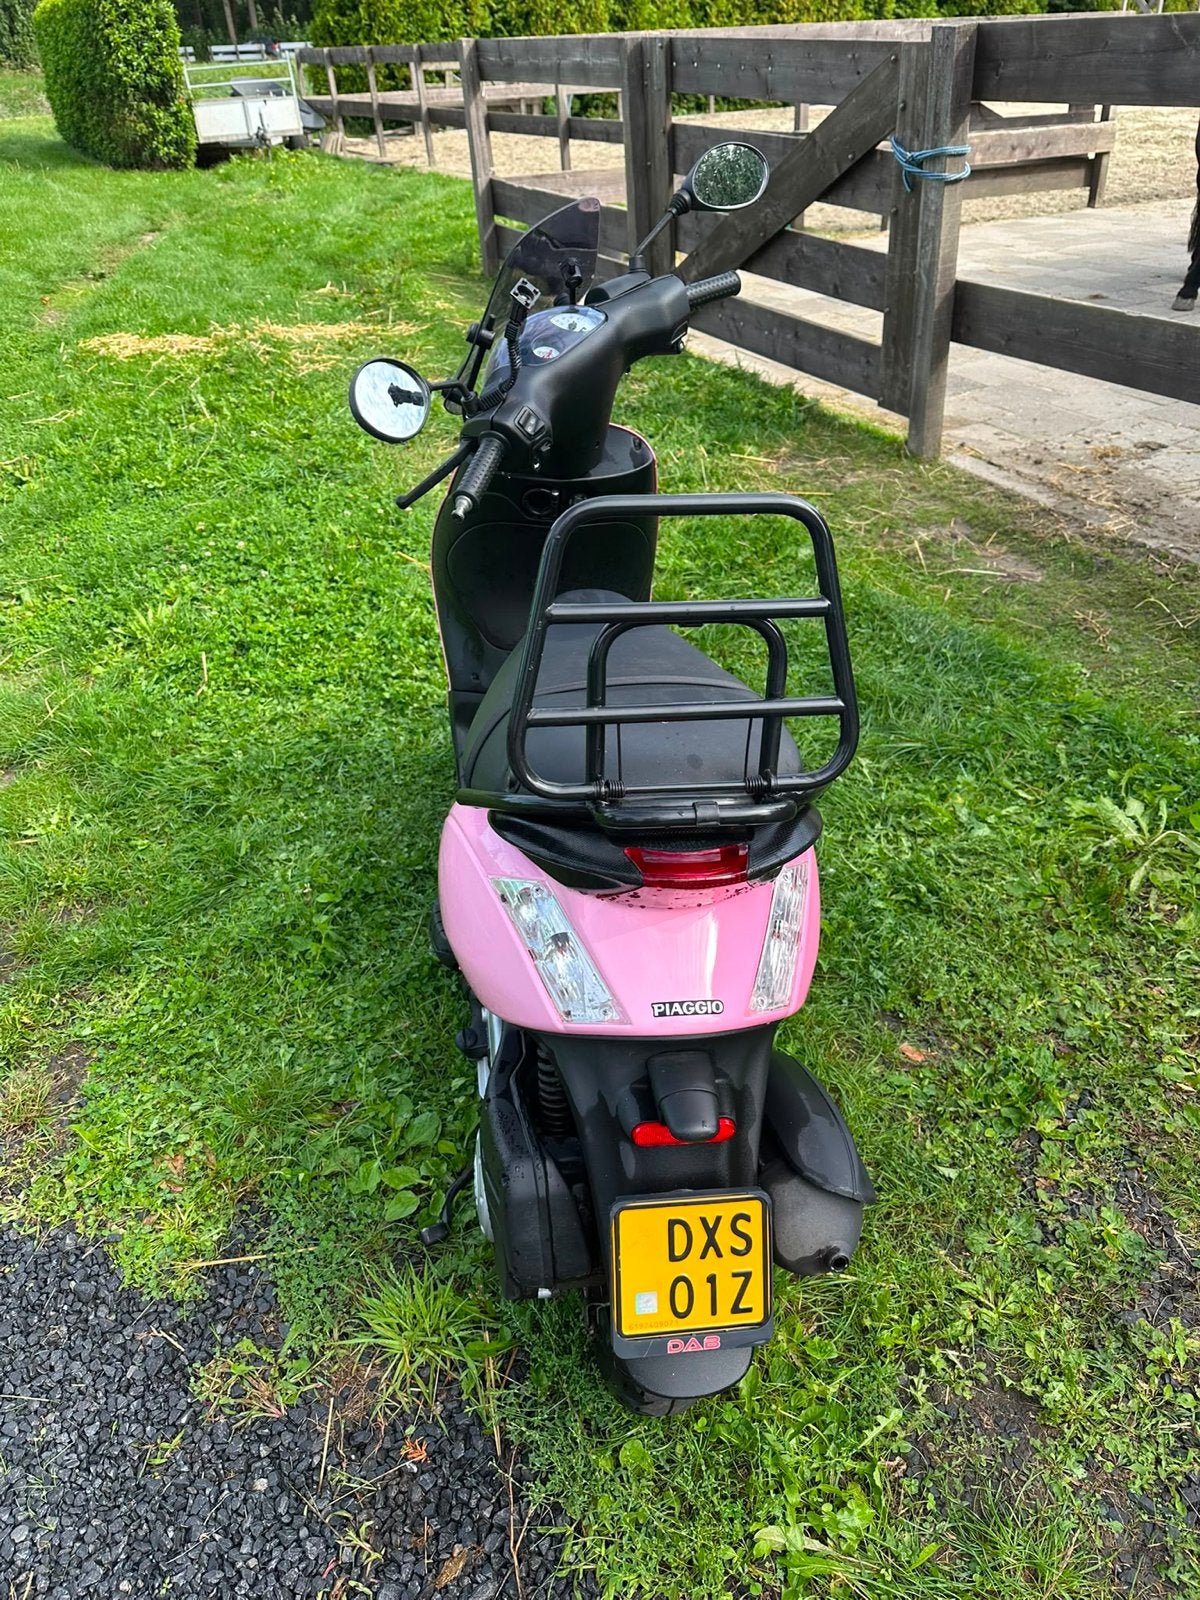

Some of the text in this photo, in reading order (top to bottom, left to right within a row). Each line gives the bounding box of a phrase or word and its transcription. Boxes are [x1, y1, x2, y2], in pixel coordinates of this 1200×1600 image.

[652, 1001, 724, 1017] PIAGGIO
[668, 1212, 753, 1262] DXS
[669, 1270, 753, 1319] 01Z
[667, 1335, 721, 1354] DAB
